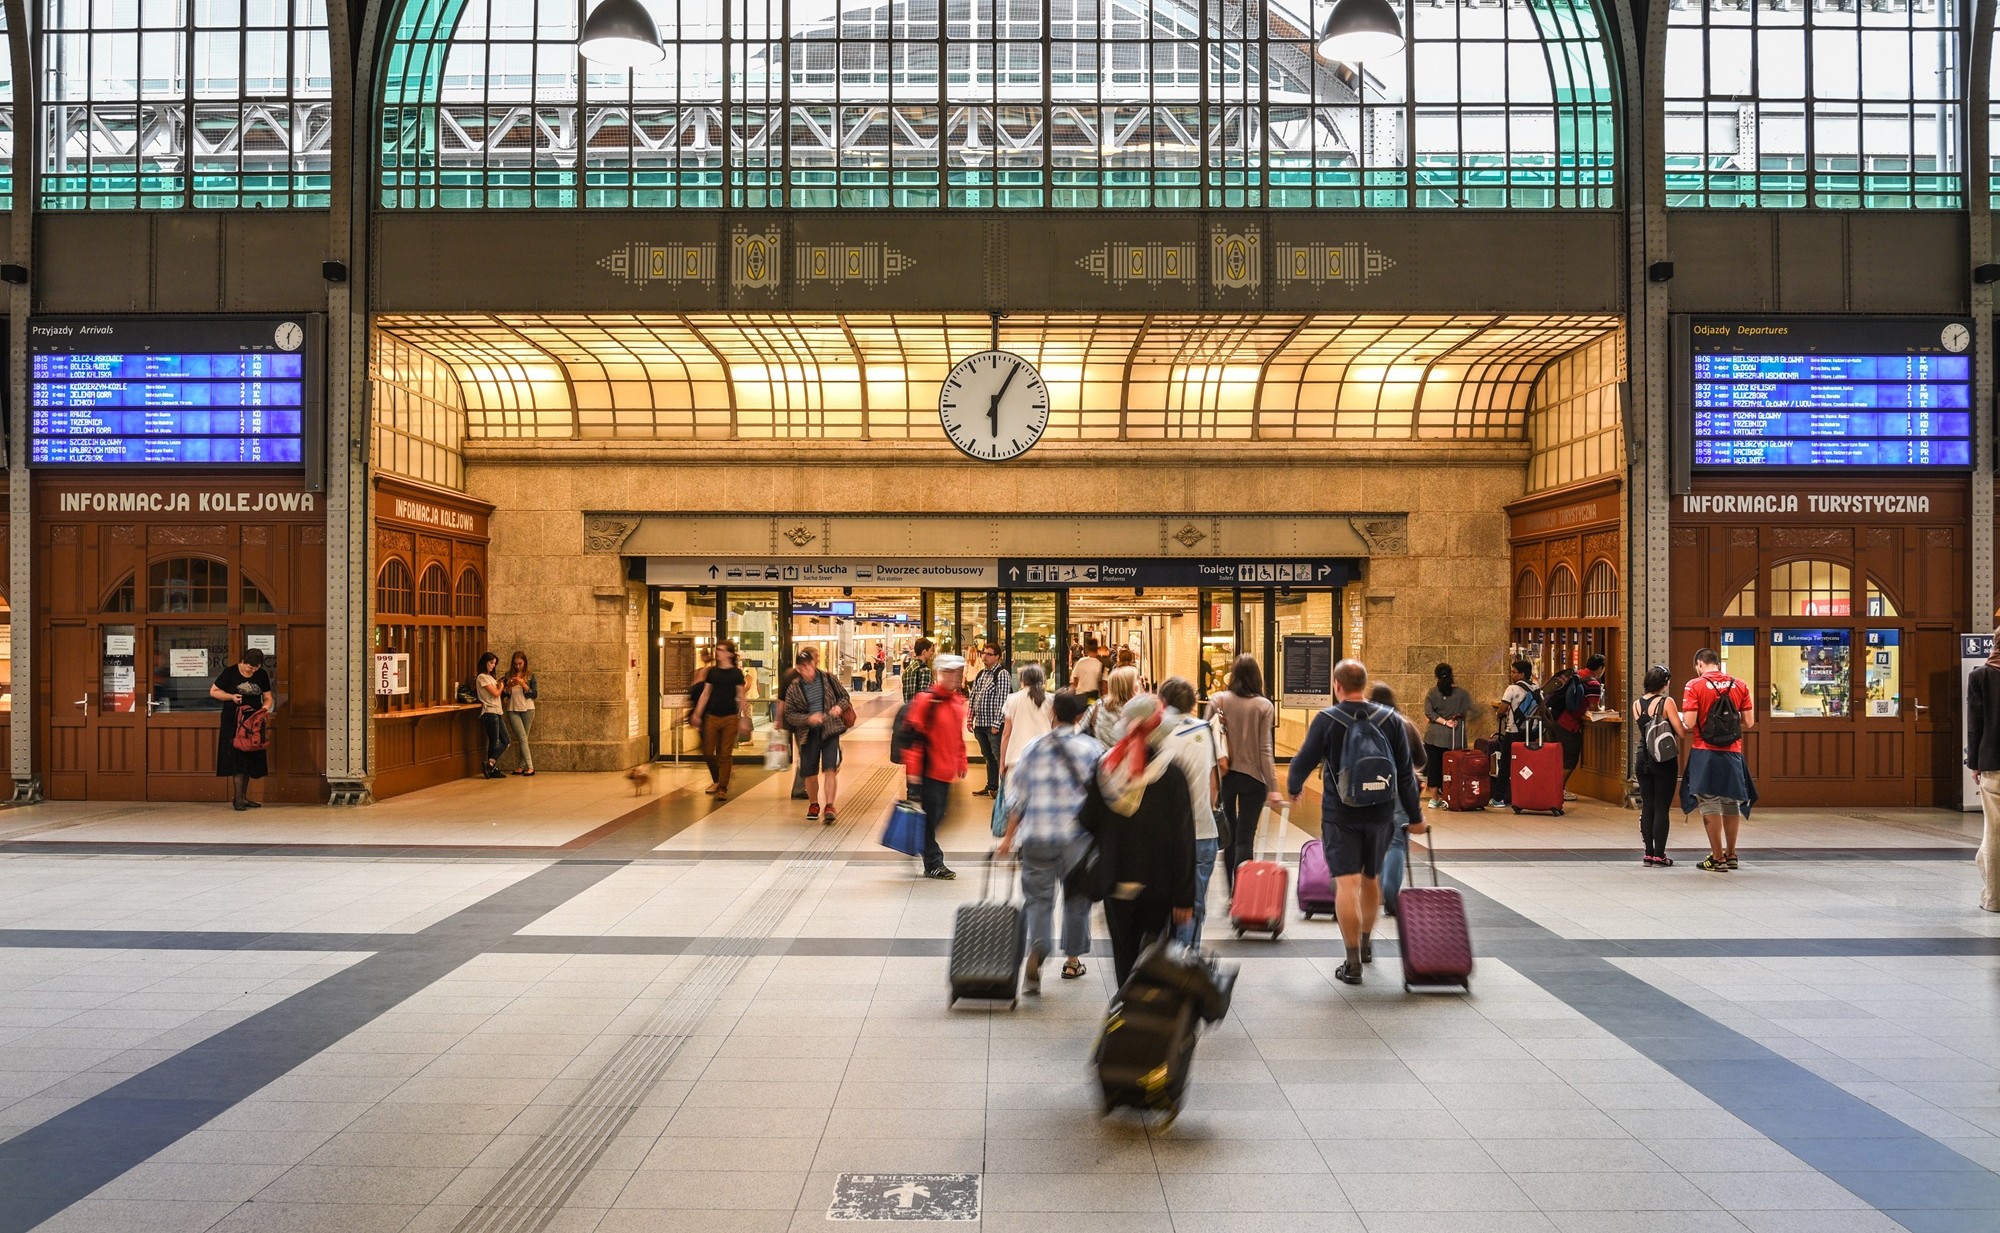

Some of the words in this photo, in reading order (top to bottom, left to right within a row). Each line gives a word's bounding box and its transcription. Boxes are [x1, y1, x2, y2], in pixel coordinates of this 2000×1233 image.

[32, 325, 73, 337] Przyjazdy
[80, 325, 114, 334] Arrivals
[1693, 325, 1731, 336] Odjazdy
[1737, 325, 1789, 336] Departures
[60, 492, 190, 512] INFORMACJA
[199, 492, 314, 512] KOLEJOWA
[1683, 494, 1798, 513] INFORMACJA
[1807, 495, 1930, 513] TURYSTYCZNA
[395, 498, 439, 525] INFORMACJA
[440, 509, 474, 531] KOLEJOWA
[803, 564, 815, 574] ul.
[817, 564, 847, 574] Sucha
[876, 564, 919, 574] Dworzec
[922, 564, 984, 577] autobusowy
[1102, 565, 1137, 576] Perony
[1198, 564, 1235, 575] Toalety
[1818, 604, 1839, 614] WROCAW
[1362, 782, 1386, 791] PUMA
